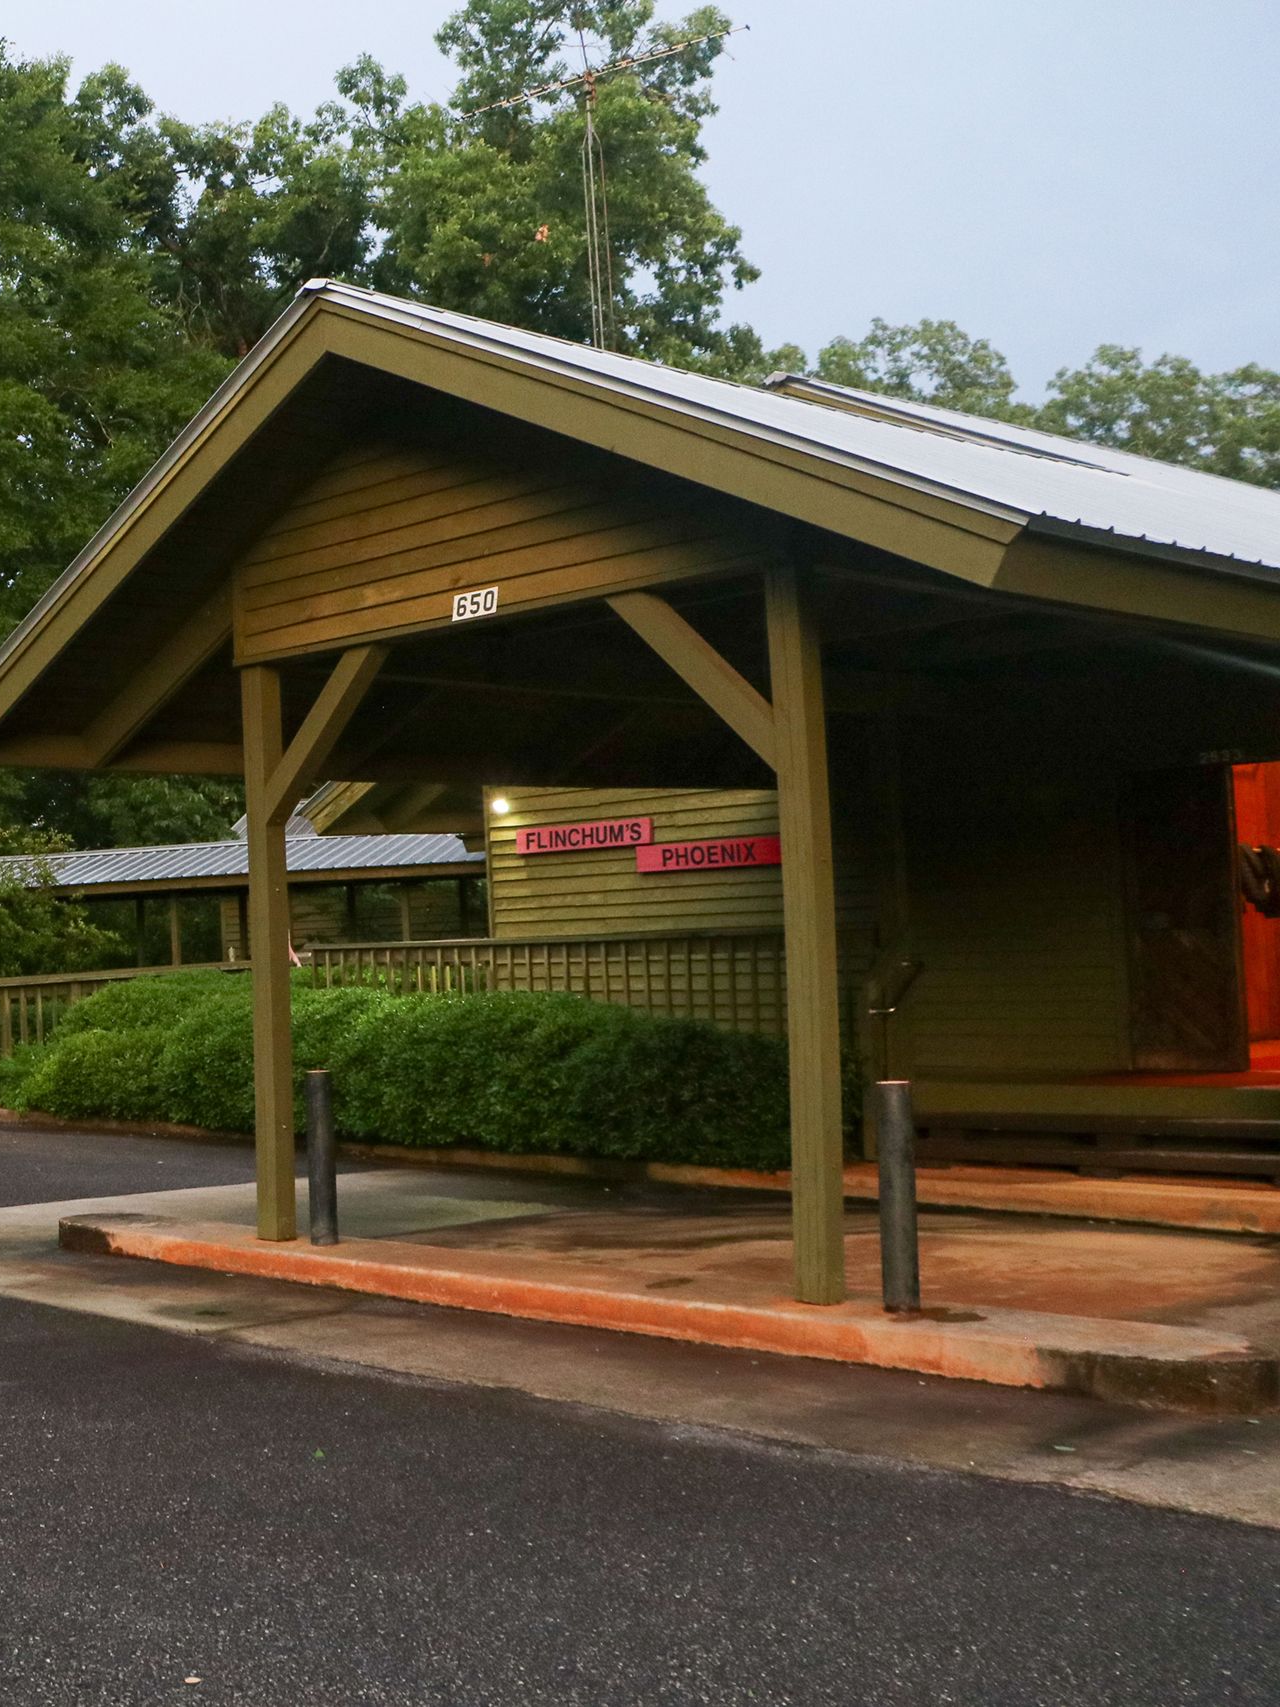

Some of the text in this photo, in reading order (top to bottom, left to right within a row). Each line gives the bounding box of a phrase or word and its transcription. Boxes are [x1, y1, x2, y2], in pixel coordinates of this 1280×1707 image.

[456, 590, 495, 617] 650
[525, 822, 642, 850] FLINCHUM'S
[662, 843, 756, 867] PHOENIX
